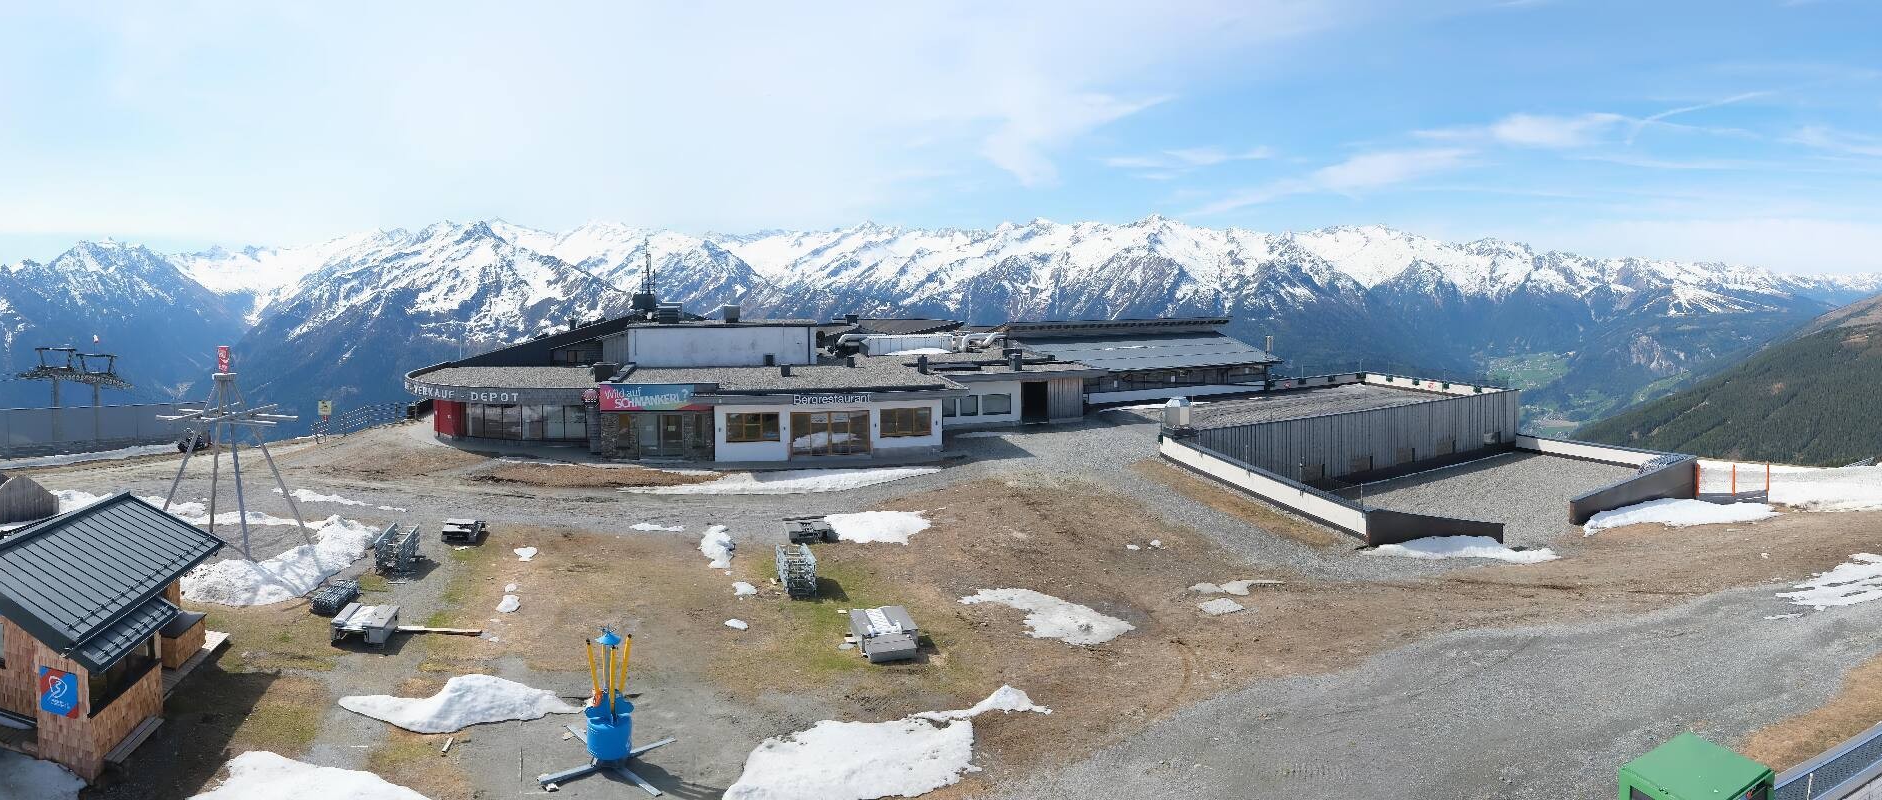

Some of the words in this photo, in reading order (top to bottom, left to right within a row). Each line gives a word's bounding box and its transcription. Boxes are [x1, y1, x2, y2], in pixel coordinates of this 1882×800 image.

[414, 384, 455, 399] VERKAUF
[470, 391, 519, 402] DEPOT
[604, 387, 625, 399] Wild
[626, 386, 642, 397] auf
[793, 393, 871, 405] Bergrestaurant
